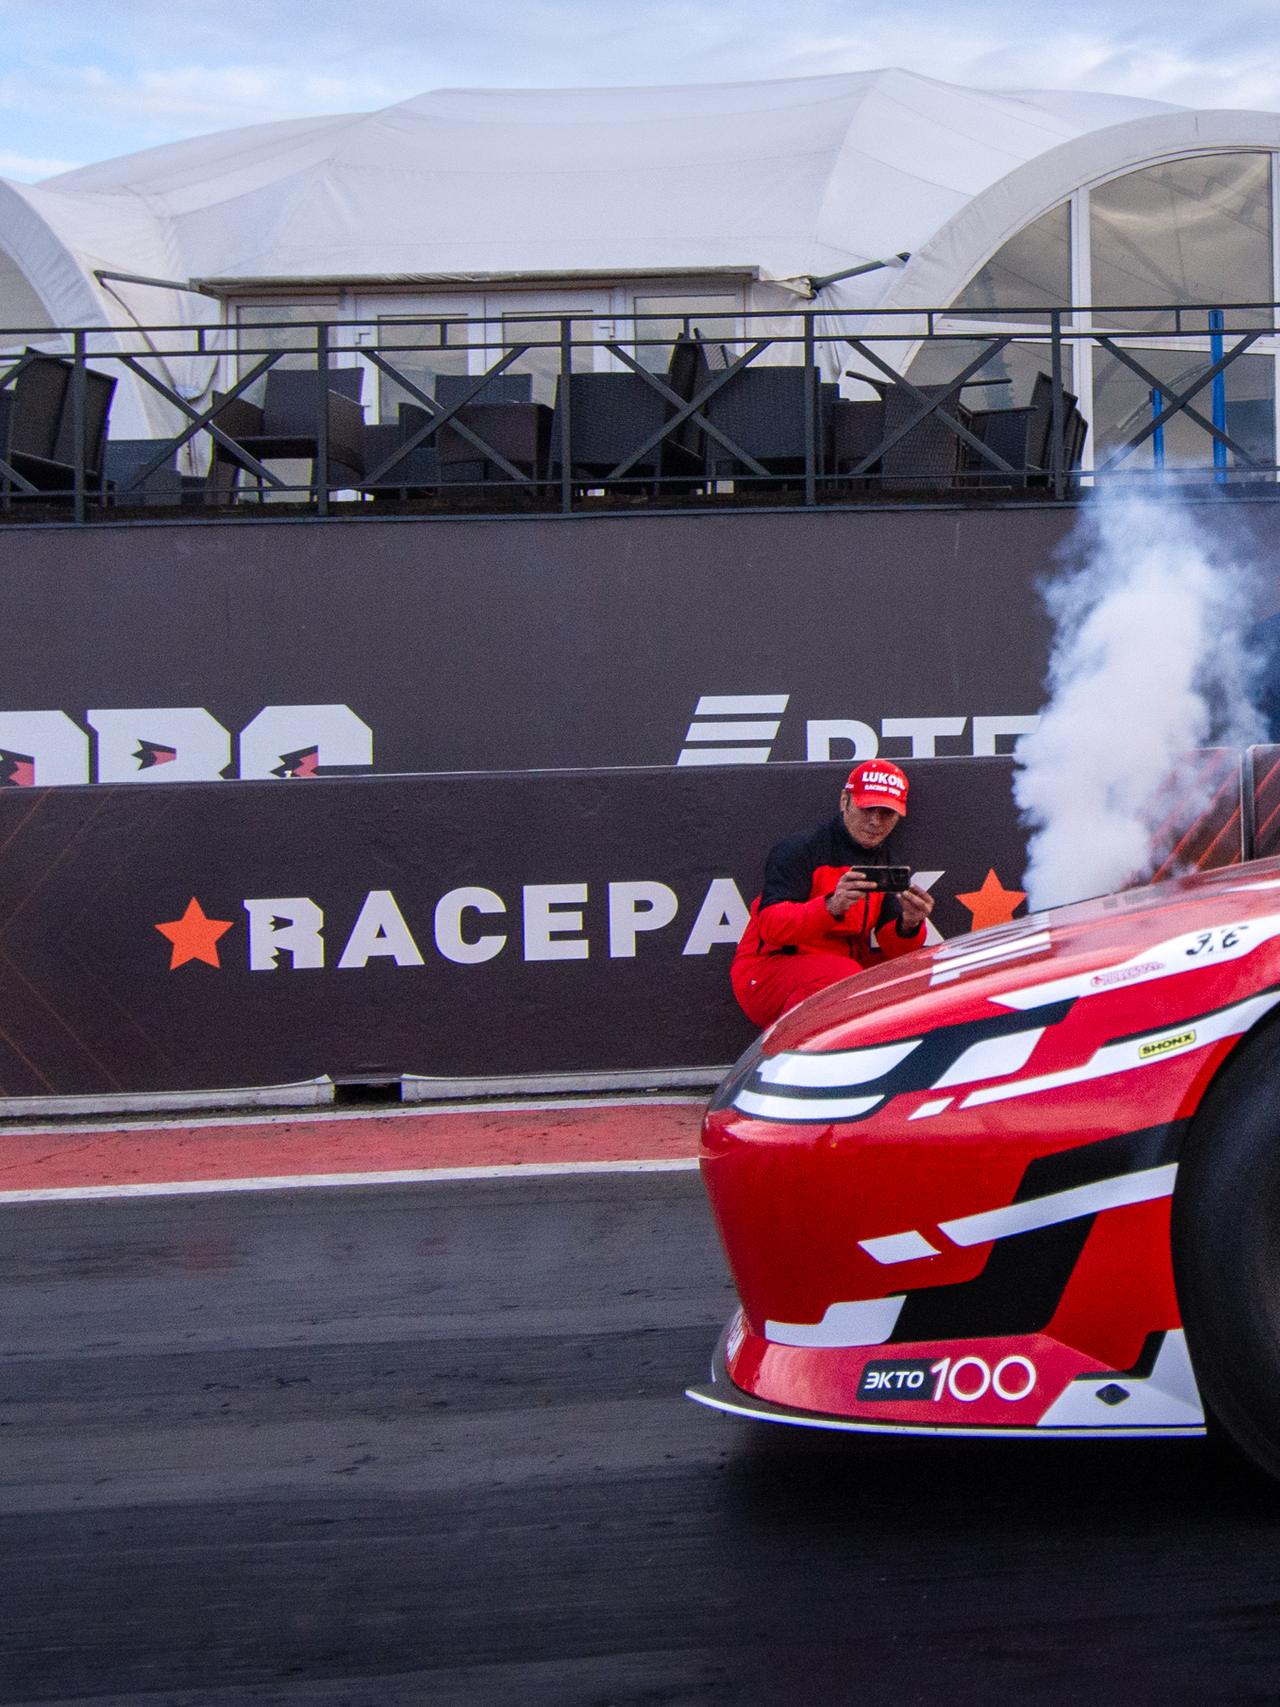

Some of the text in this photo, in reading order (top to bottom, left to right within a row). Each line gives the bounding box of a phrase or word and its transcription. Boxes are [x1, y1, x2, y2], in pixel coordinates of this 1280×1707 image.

[861, 771, 905, 790] LUKOIL
[863, 1355, 1037, 1403] ЭКТО 100
